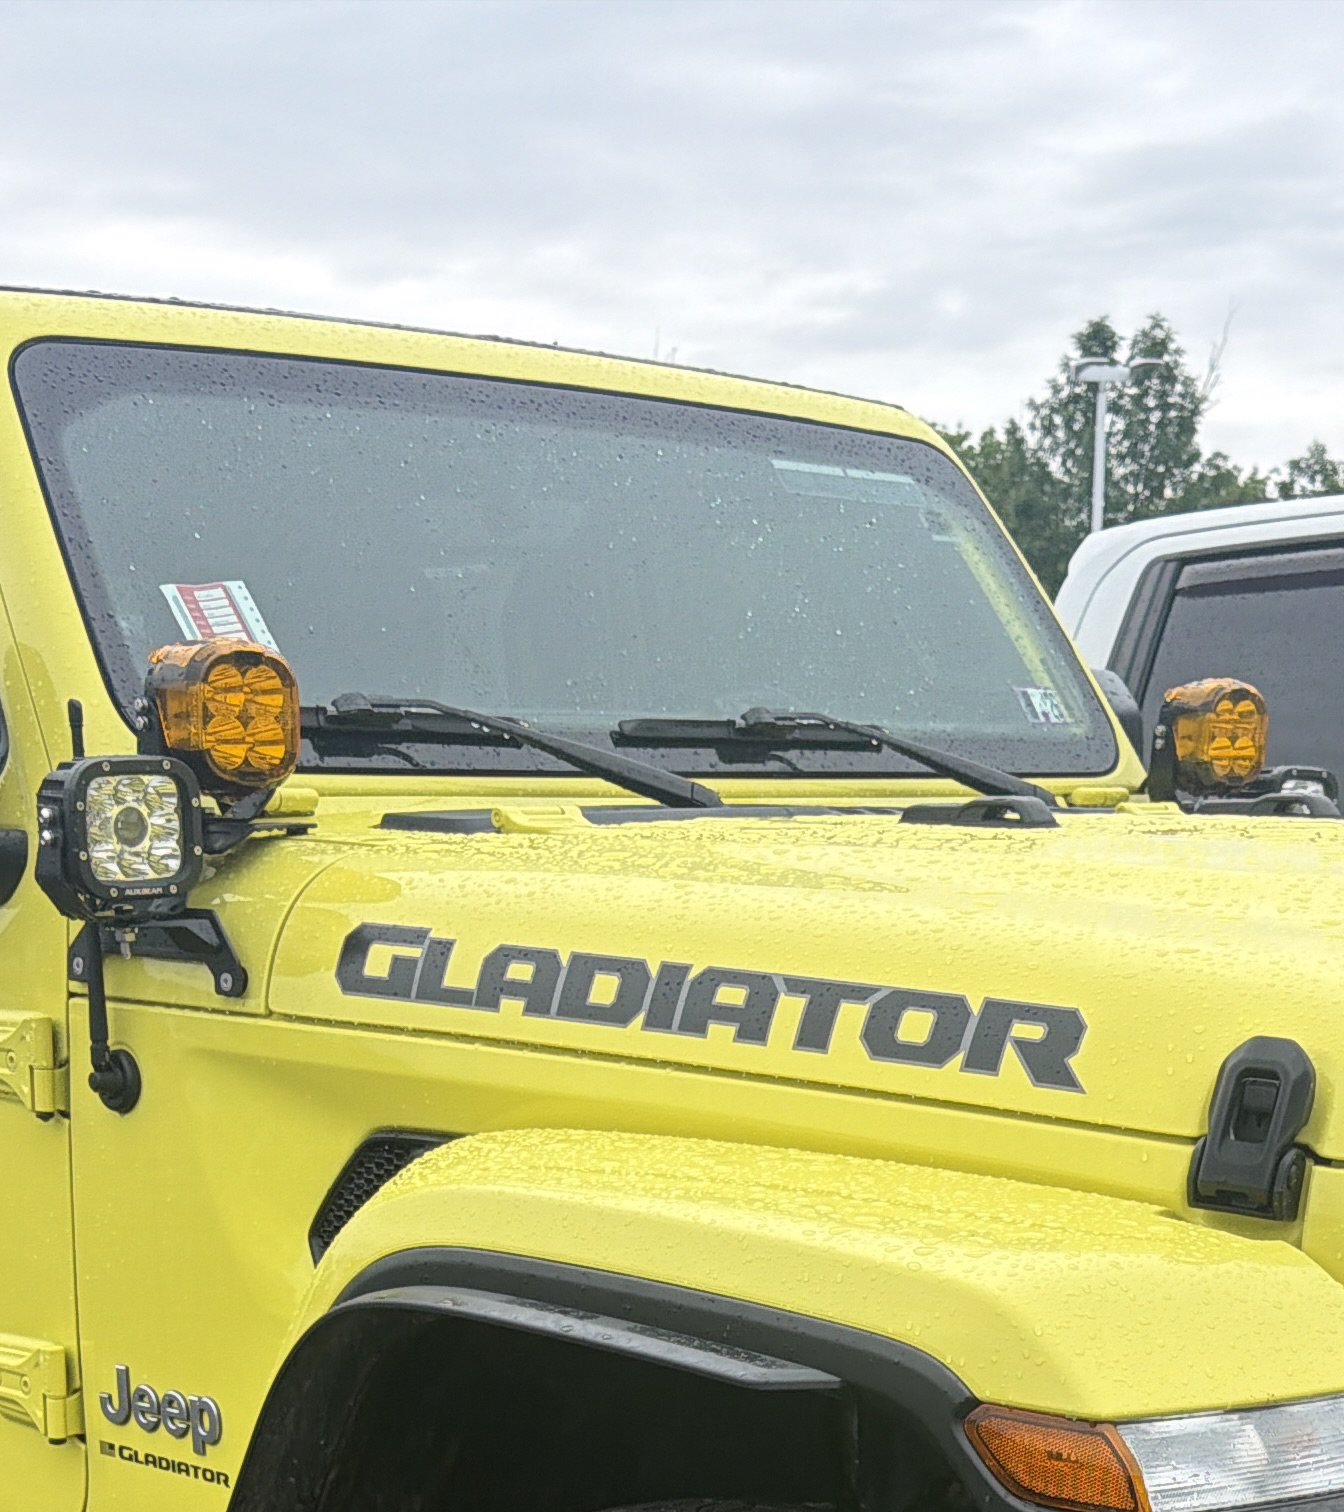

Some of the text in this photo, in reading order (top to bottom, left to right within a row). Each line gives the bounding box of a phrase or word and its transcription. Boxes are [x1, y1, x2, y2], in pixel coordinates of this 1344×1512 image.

[335, 921, 1088, 1095] GLADIATOR
[99, 1363, 223, 1457] Jeep
[118, 1445, 231, 1489] GLADIATOR
